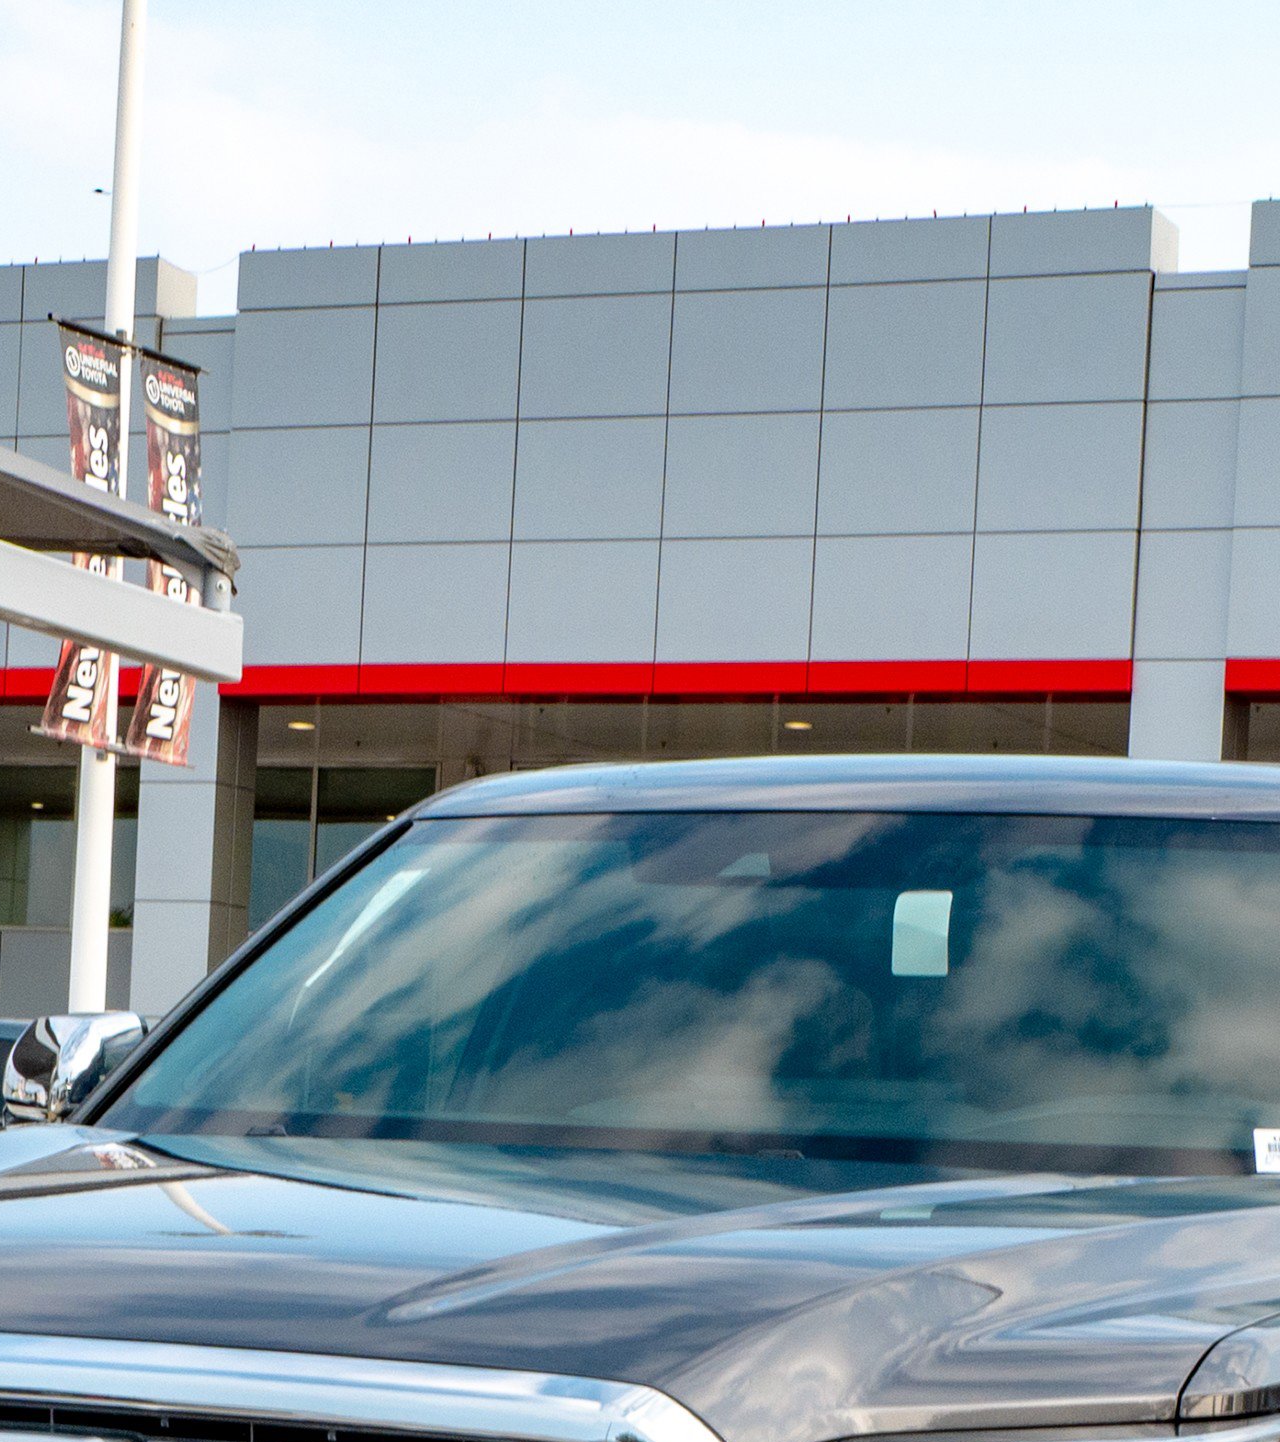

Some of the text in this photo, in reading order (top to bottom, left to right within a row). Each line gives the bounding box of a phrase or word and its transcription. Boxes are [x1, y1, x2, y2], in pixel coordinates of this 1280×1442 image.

[80, 353, 118, 378] UNIVERSAL
[81, 365, 108, 387] TOYOTA
[158, 381, 196, 406] UNIVERSAL
[160, 396, 186, 415] TOYOTA
